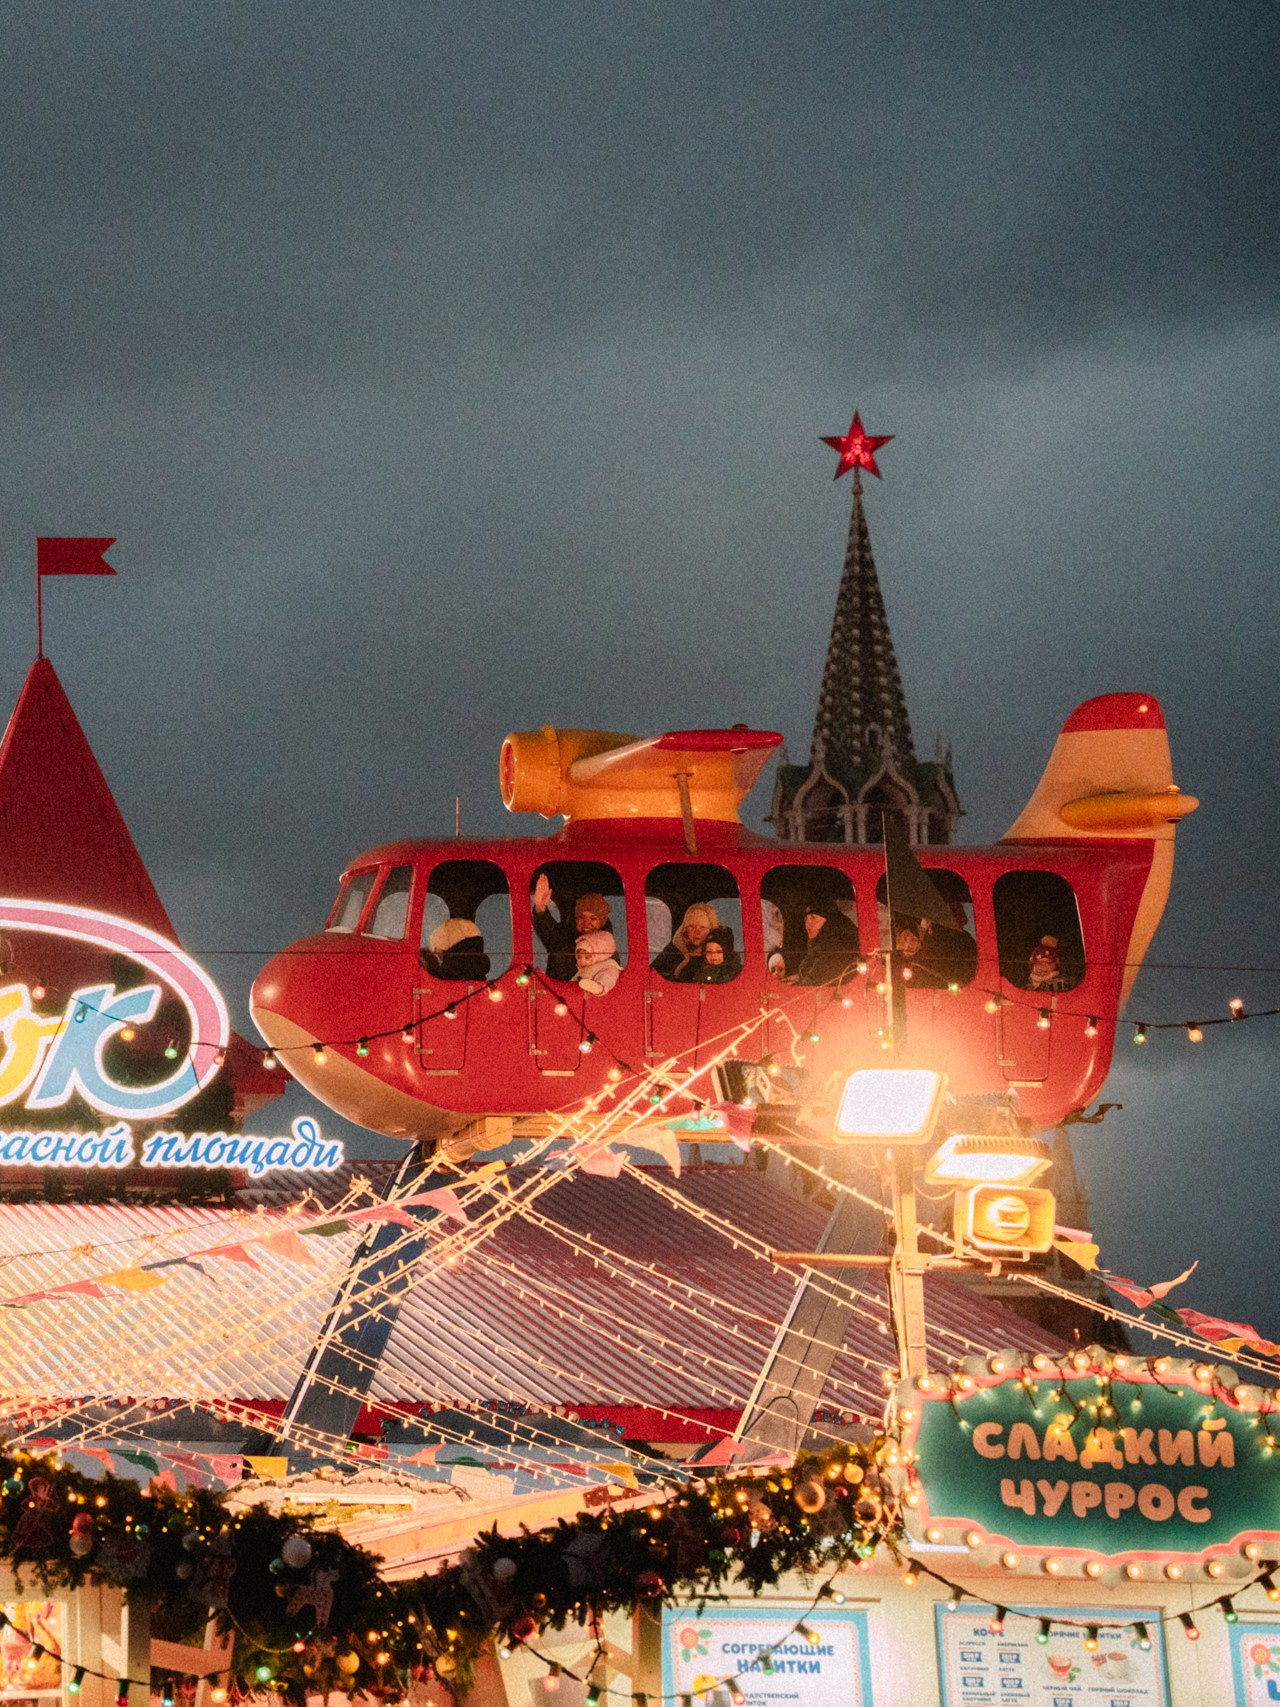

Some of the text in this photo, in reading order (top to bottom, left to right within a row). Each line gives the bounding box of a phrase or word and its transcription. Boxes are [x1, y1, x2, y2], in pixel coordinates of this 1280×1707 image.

[144, 1119, 341, 1176] площади
[972, 1417, 1236, 1470] СЛАДКИЙ
[999, 1478, 1212, 1524] ЧУРРОС
[1048, 1630, 1080, 1639] ОРЯЧИЕ
[737, 1659, 821, 1675] НАИТКИ
